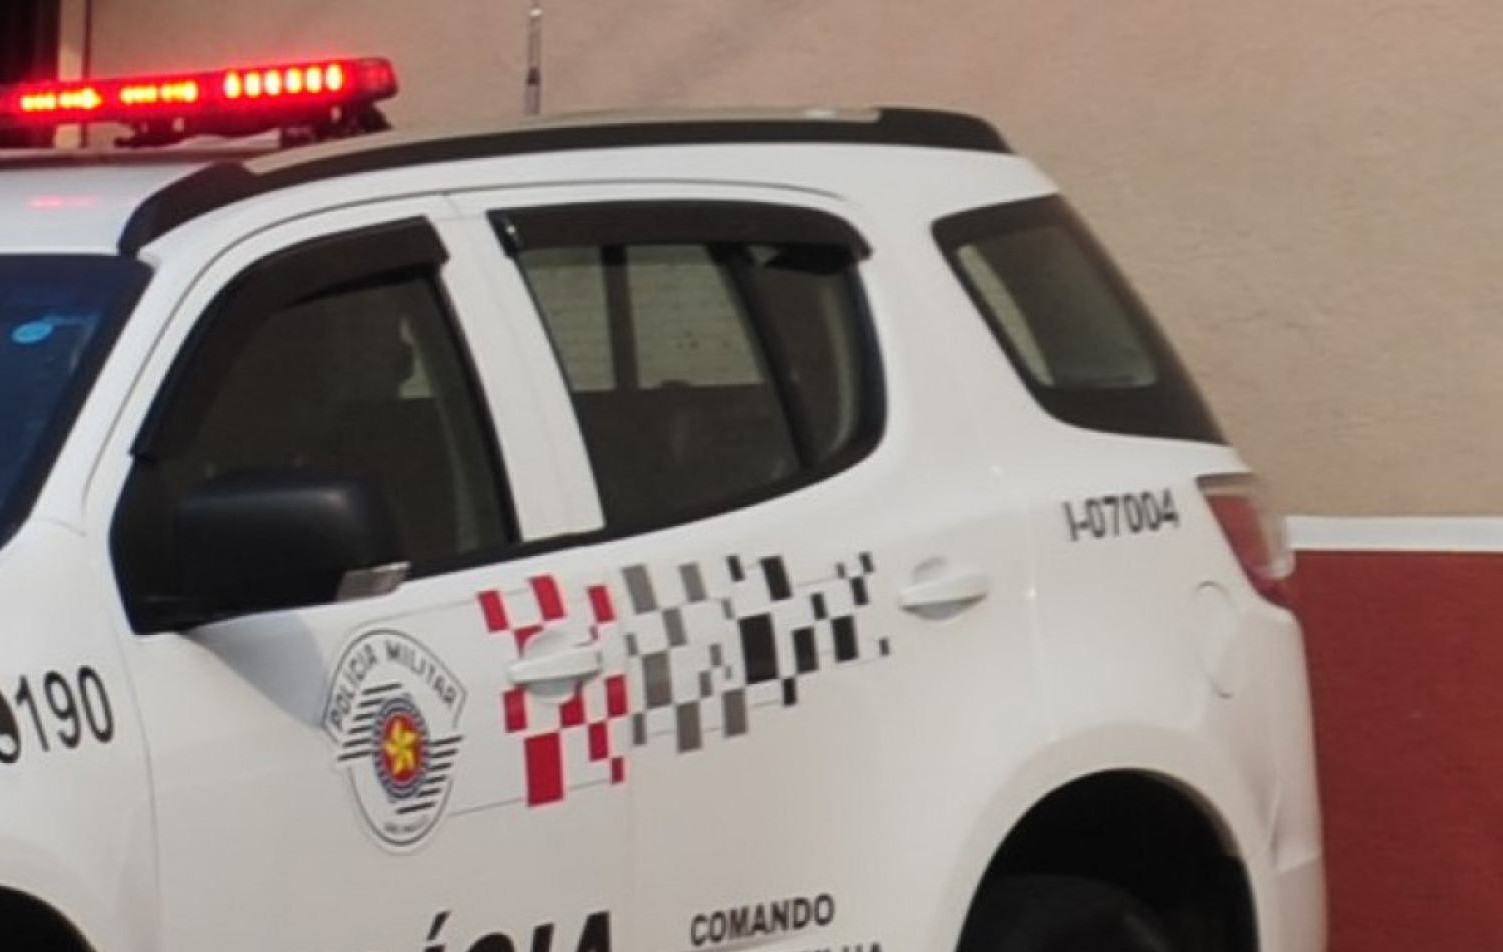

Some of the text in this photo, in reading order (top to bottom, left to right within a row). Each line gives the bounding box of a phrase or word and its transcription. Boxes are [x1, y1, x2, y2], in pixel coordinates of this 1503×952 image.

[1062, 487, 1179, 542] I-07004
[385, 639, 458, 706] MILITAR
[15, 665, 114, 752] 190
[690, 893, 835, 946] COMANDO
